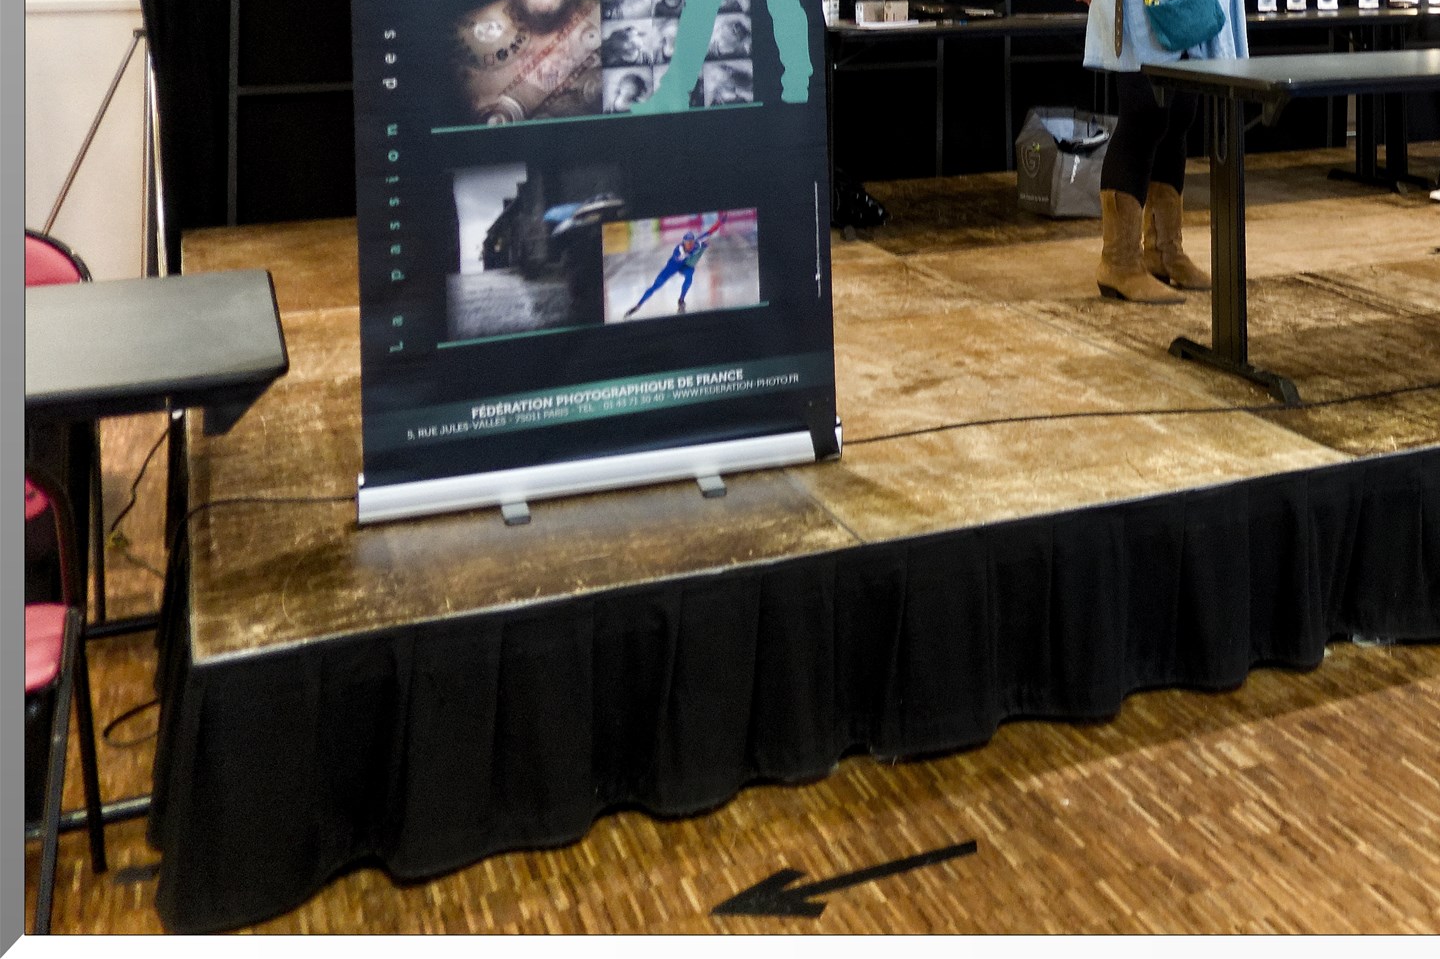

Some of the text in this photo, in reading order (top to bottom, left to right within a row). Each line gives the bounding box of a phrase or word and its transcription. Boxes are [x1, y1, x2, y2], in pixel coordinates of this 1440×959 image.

[382, 28, 398, 90] des
[385, 122, 405, 283] passion
[418, 425, 438, 438] RUE
[543, 407, 569, 420] PARIS
[471, 368, 743, 420] FÉDÉRATION PHOTOGRAPHIQUE DE FRANCE
